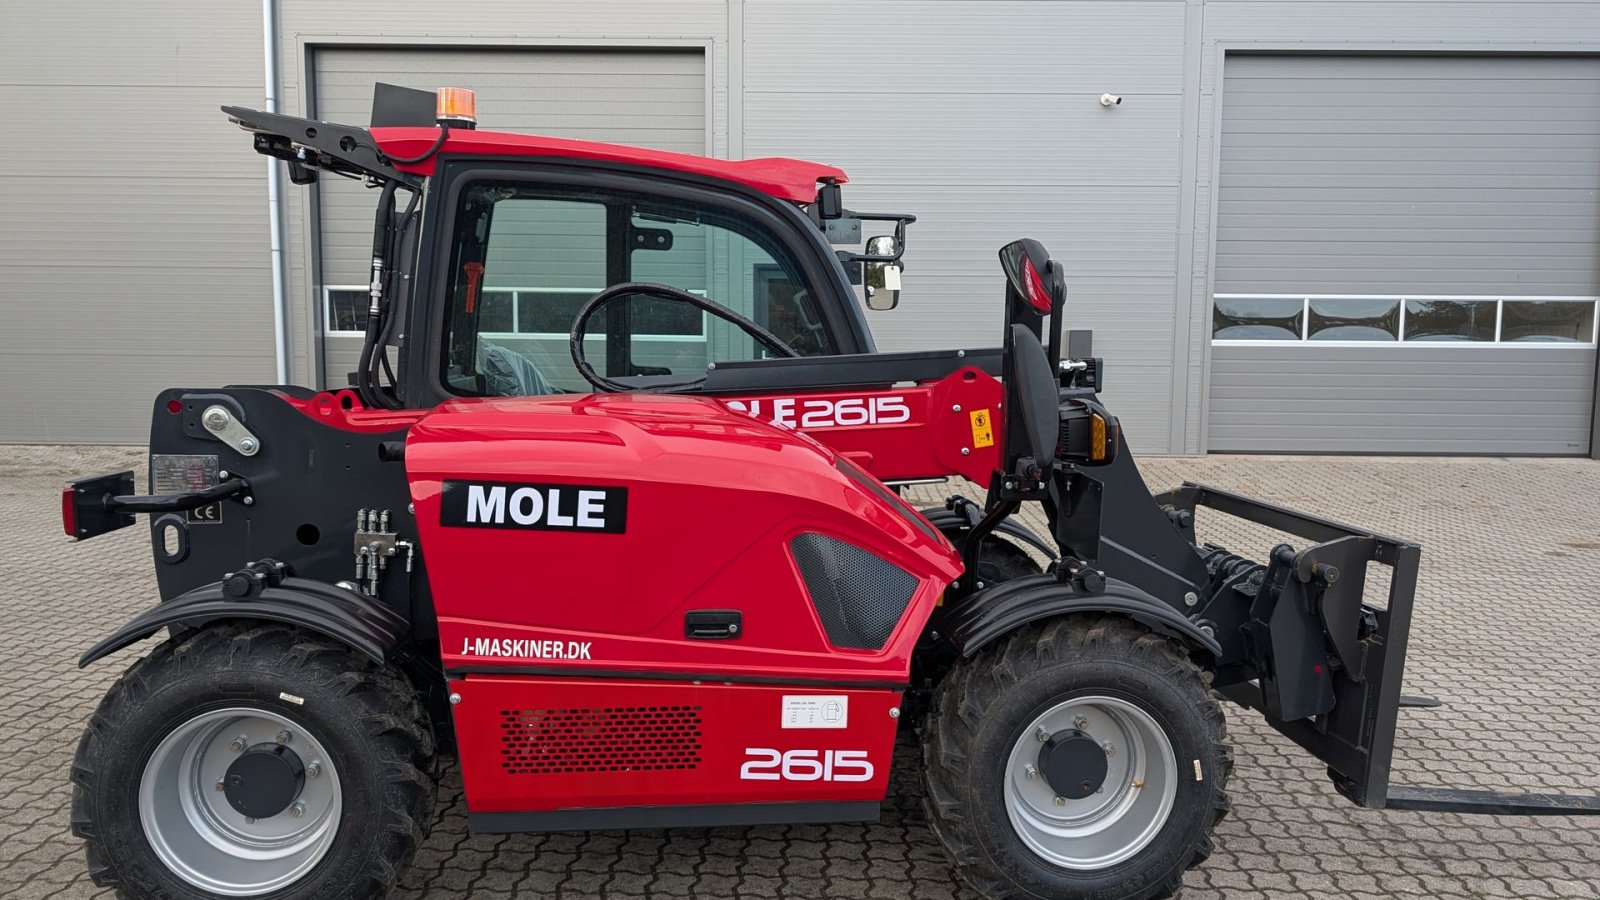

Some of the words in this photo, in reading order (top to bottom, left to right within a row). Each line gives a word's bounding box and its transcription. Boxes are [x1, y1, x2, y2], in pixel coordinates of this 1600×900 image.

[801, 397, 911, 428] 2615
[466, 485, 607, 528] MOLE
[461, 637, 592, 660] J-MASKINER.DK
[740, 748, 874, 782] 2615
